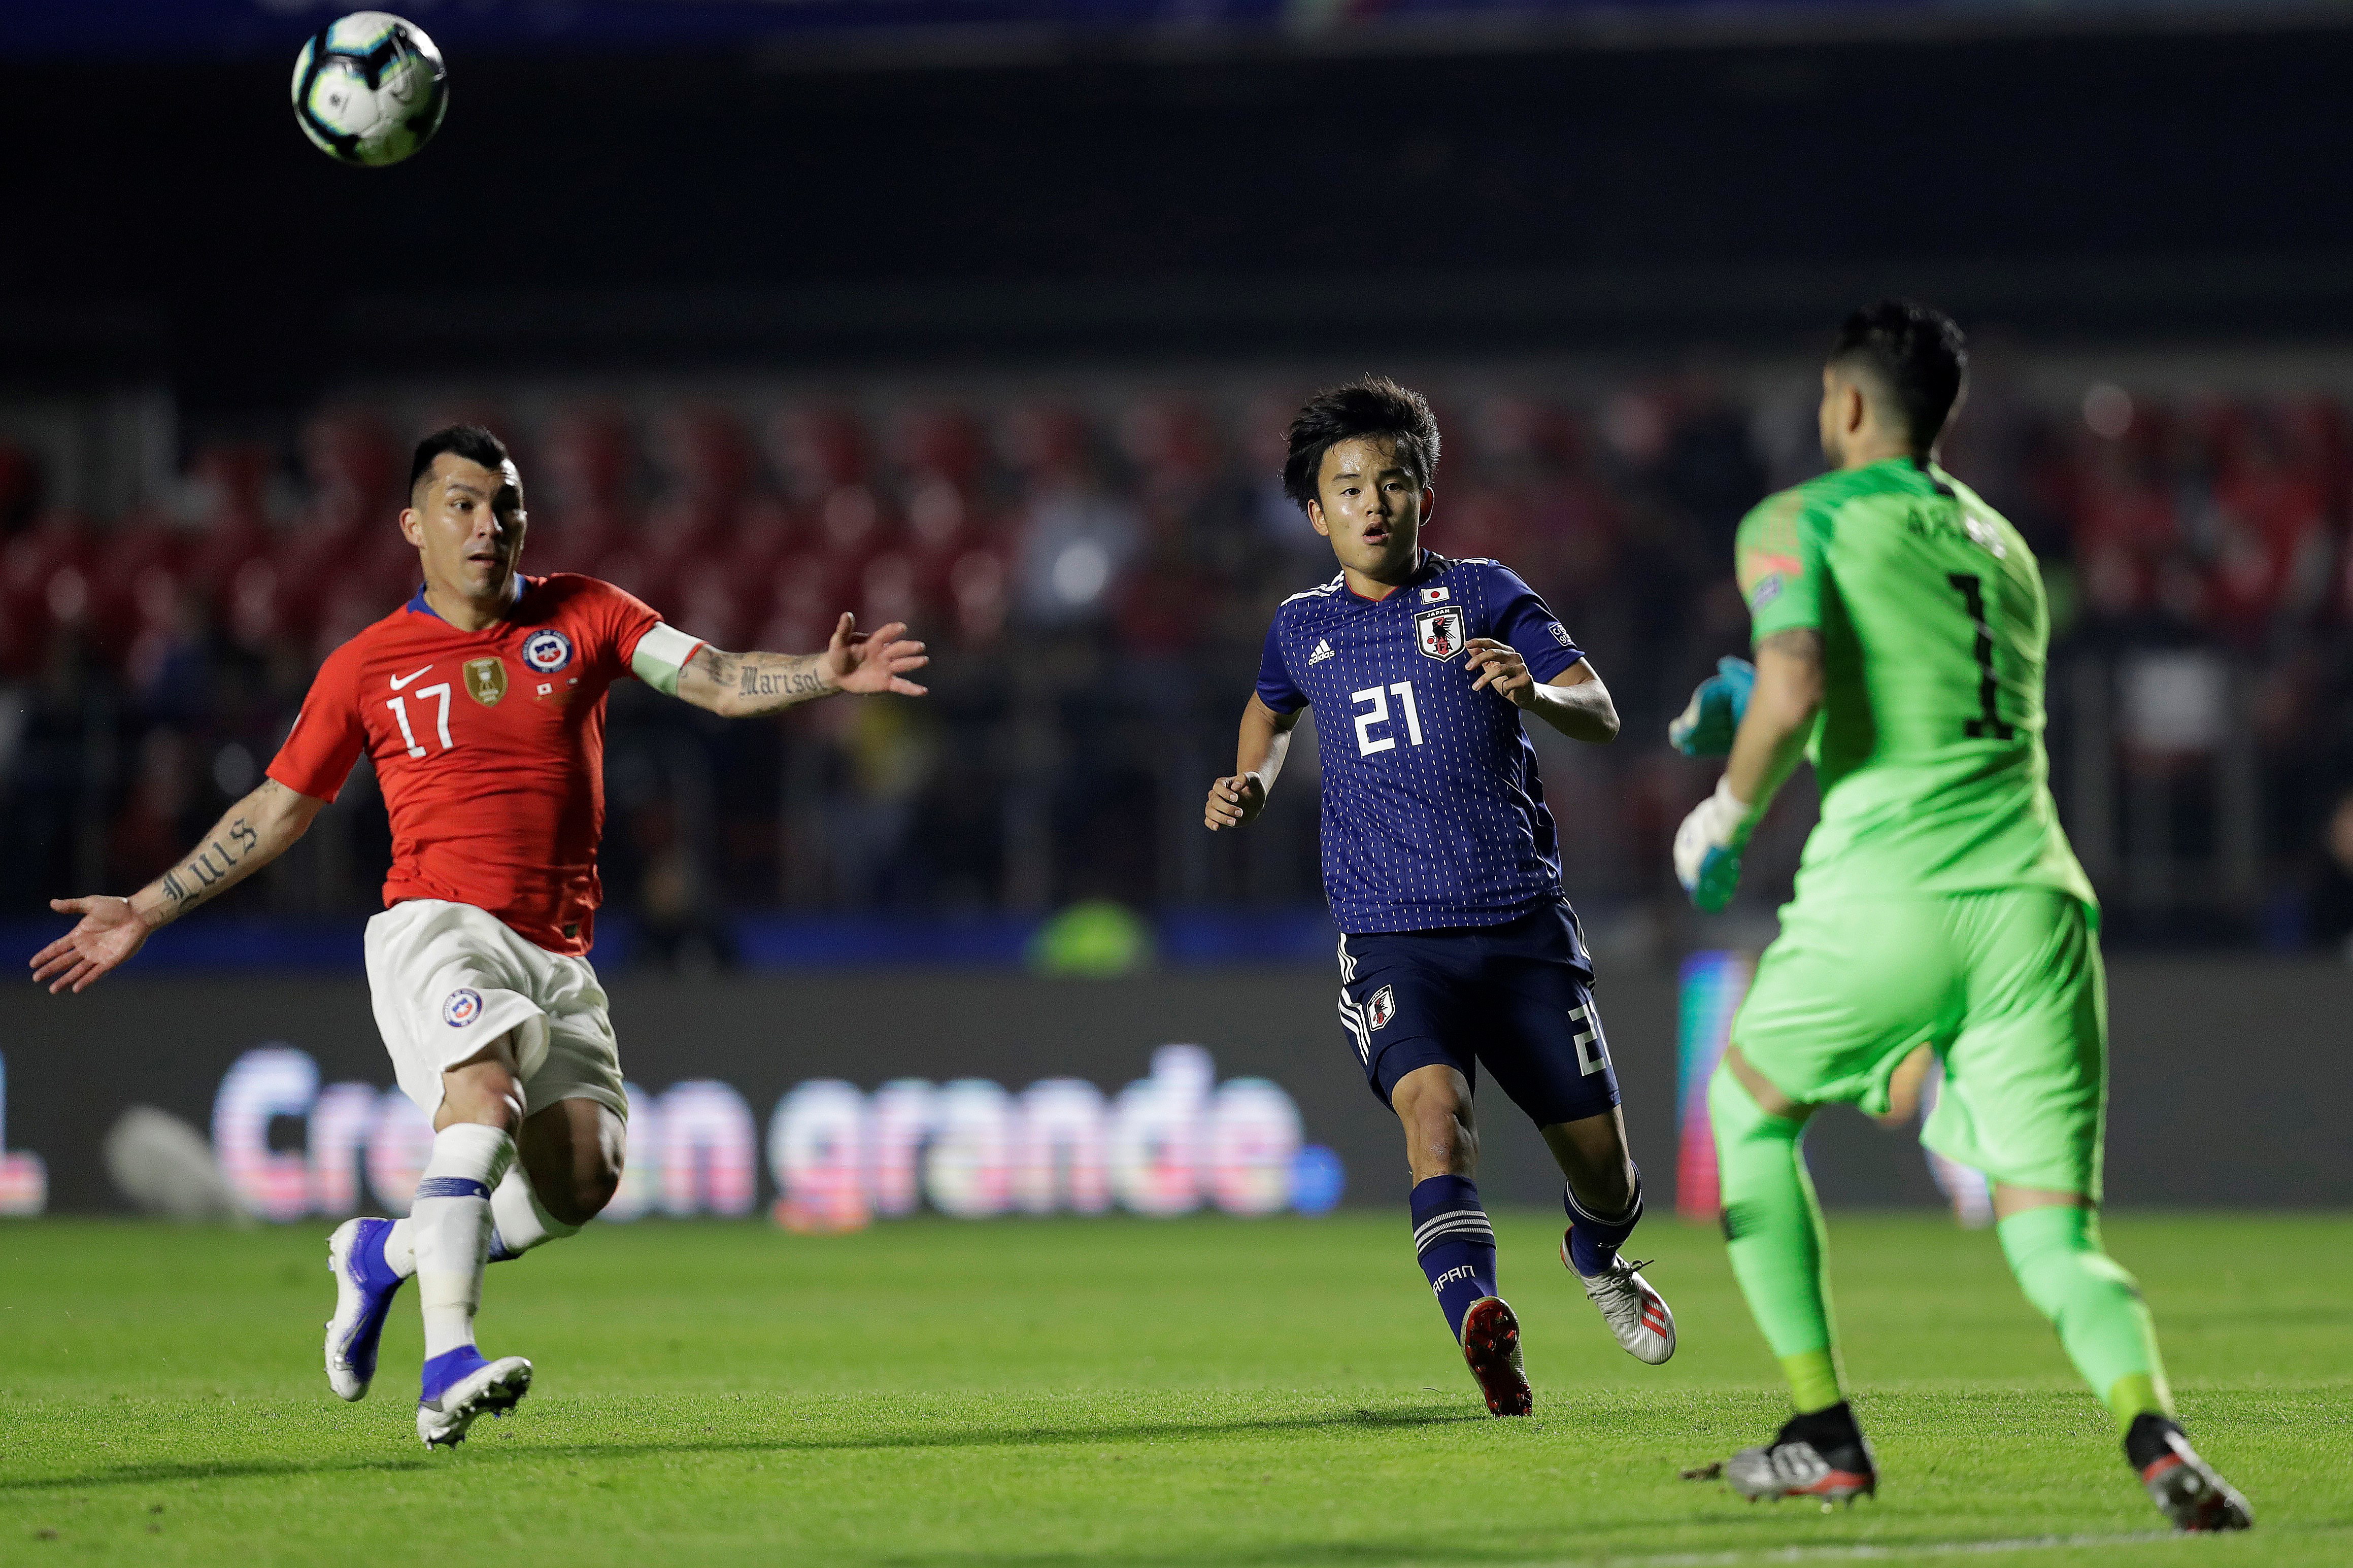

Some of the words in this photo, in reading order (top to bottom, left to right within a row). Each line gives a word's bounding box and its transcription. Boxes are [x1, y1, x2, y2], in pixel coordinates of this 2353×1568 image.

[1426, 608, 1450, 618] JAPAN
[738, 665, 827, 700] Marisol
[1308, 650, 1335, 666] adidas
[1948, 572, 2013, 739] 1
[386, 682, 454, 759] 17
[1352, 680, 1423, 757] 21
[767, 1041, 1303, 1232] grande
[1433, 1265, 1475, 1297] APAN
